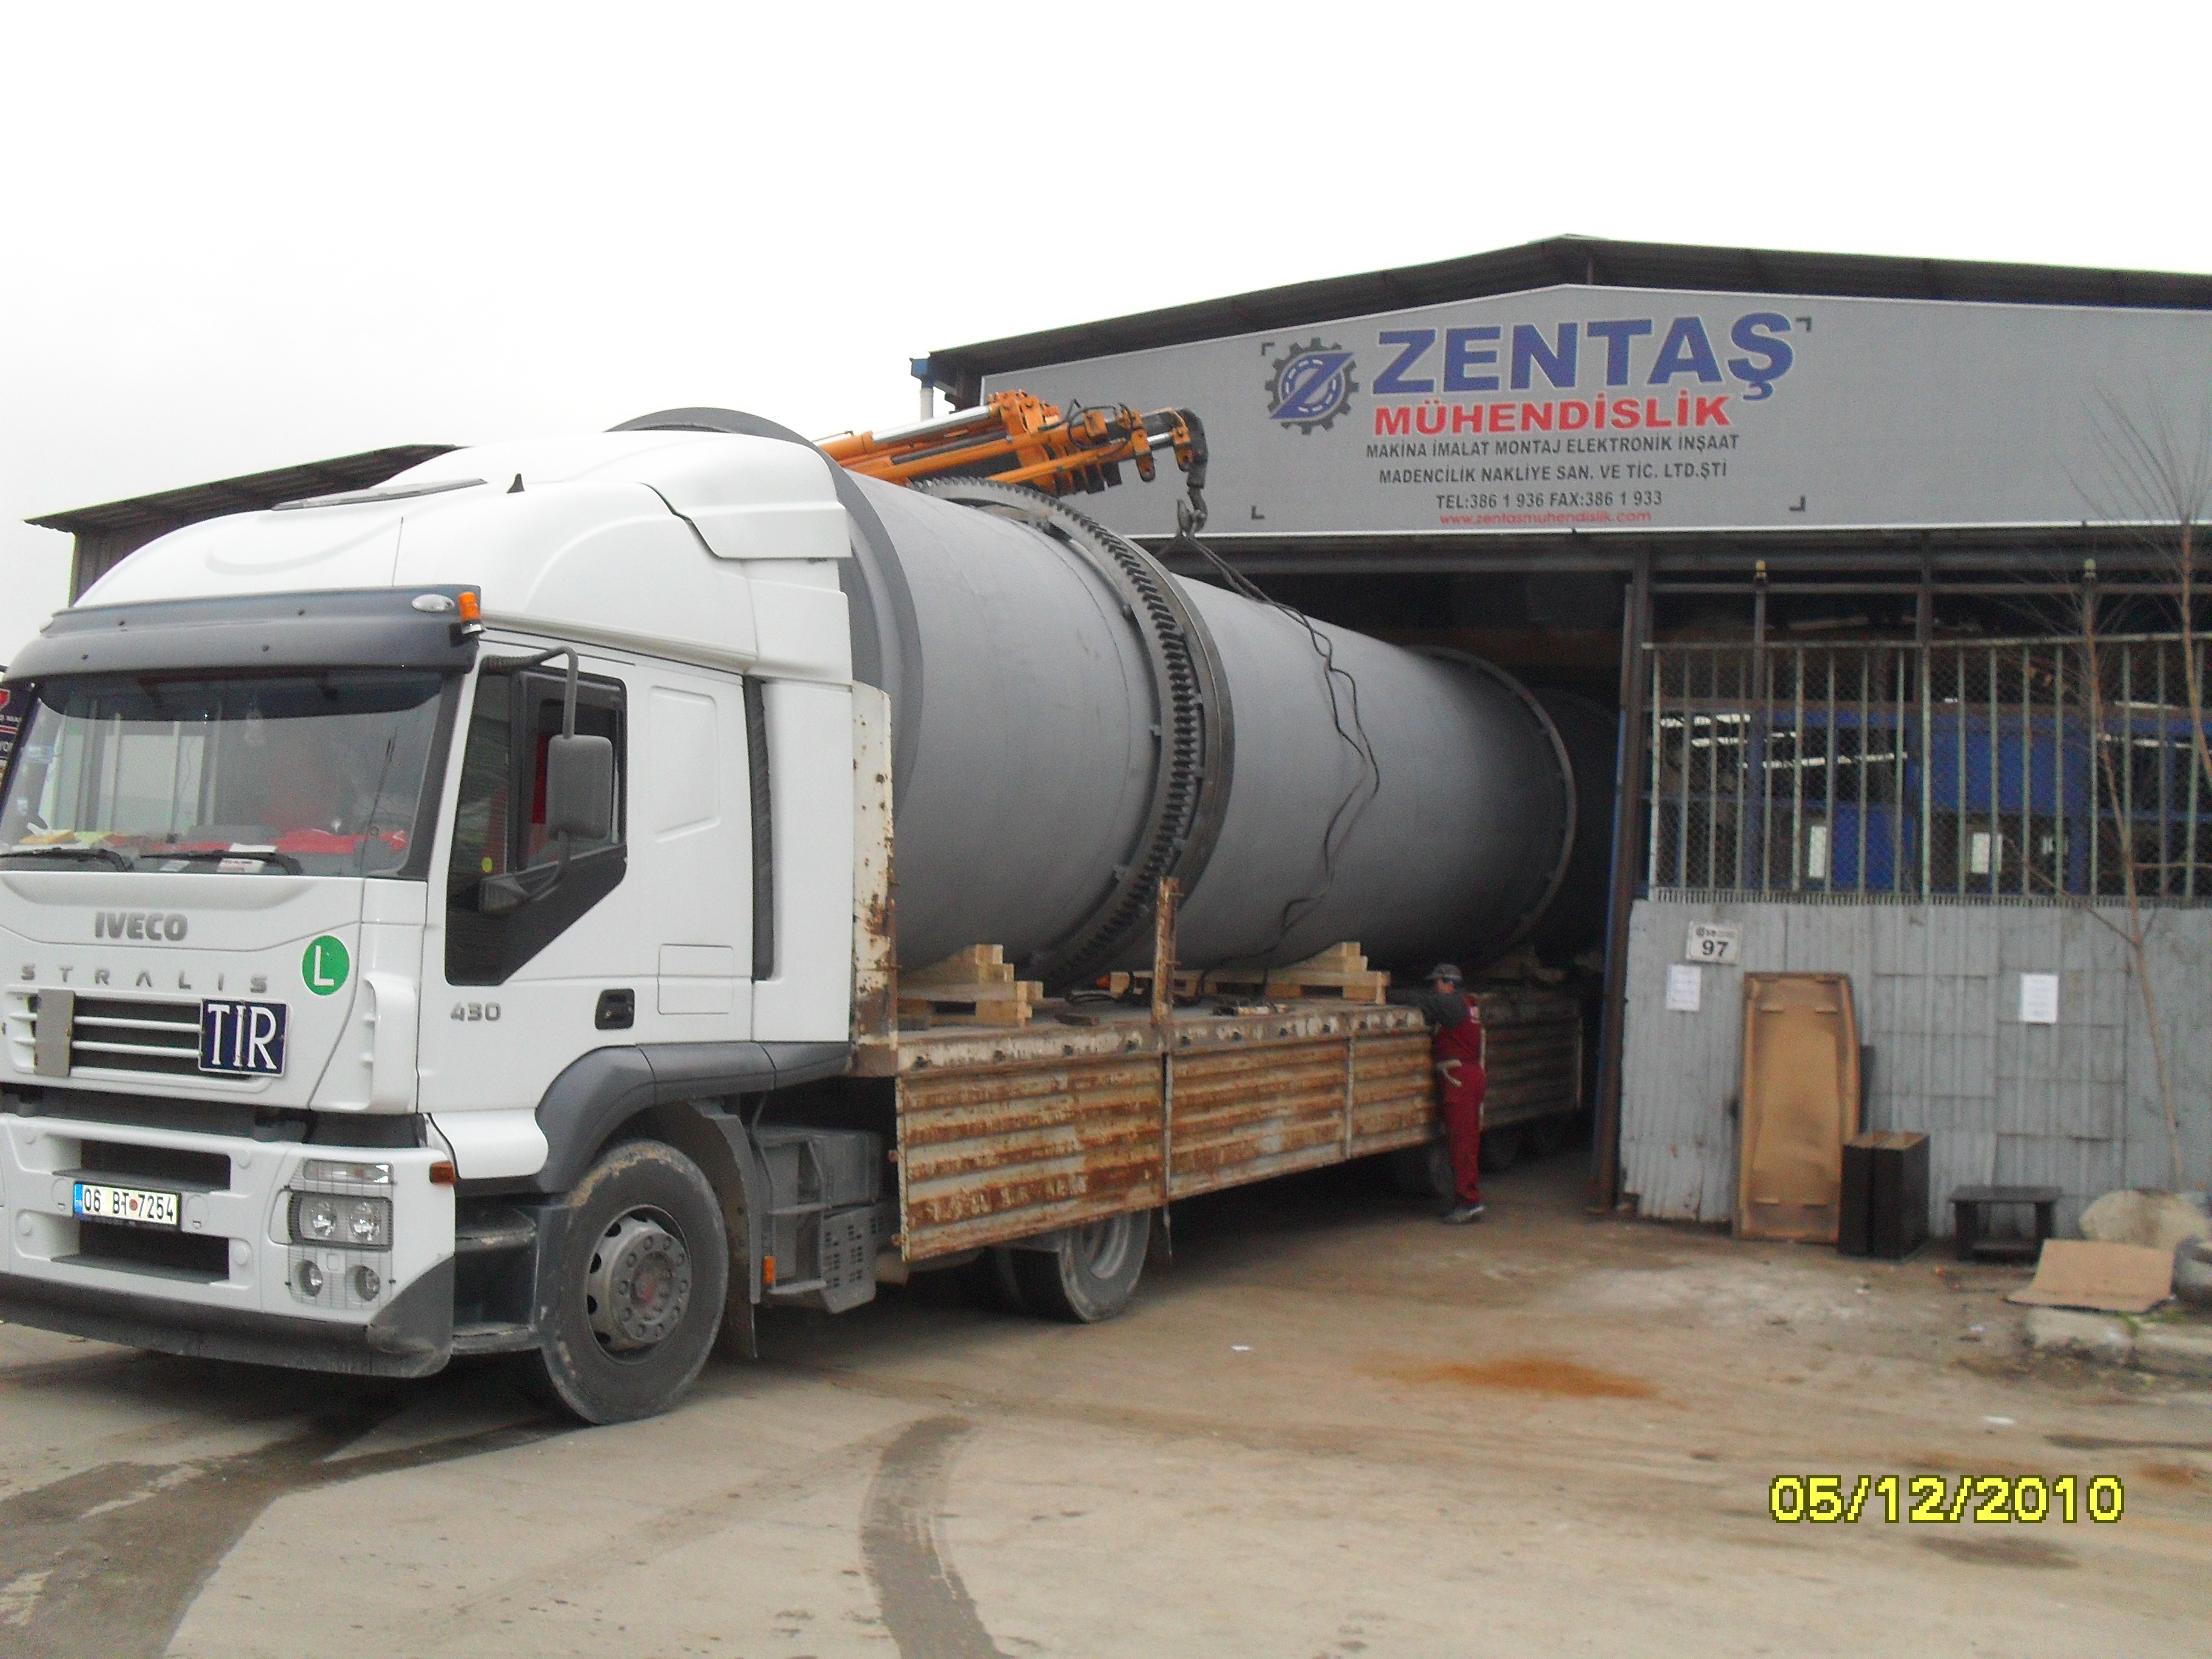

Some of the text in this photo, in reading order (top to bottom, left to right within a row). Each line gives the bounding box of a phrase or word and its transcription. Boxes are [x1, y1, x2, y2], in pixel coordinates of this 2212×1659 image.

[1372, 312, 1794, 401] ZENTAŞ
[1375, 389, 1731, 436] MÜHENDİSLİK
[1366, 432, 1739, 457] MAKİNA İMALAT MONTAJ ELEKTRONİK İNŞAAT
[1379, 465, 1475, 484] MADENCİLİK
[1481, 463, 1551, 481] NAKLİYE
[1557, 464, 1594, 480] SAN.
[1600, 464, 1620, 479] VE
[1626, 461, 1658, 478] TİC.
[1436, 490, 1662, 509] TEL:386 1 936 FAX:386 1 933
[95, 911, 187, 941] IVECO
[1702, 940, 1729, 956] 97
[21, 964, 268, 993] STRALIS
[314, 945, 335, 986] L
[451, 1002, 501, 1022] 430
[207, 1004, 278, 1070] TIR
[84, 1187, 101, 1212] 06
[138, 1193, 174, 1221] 7254
